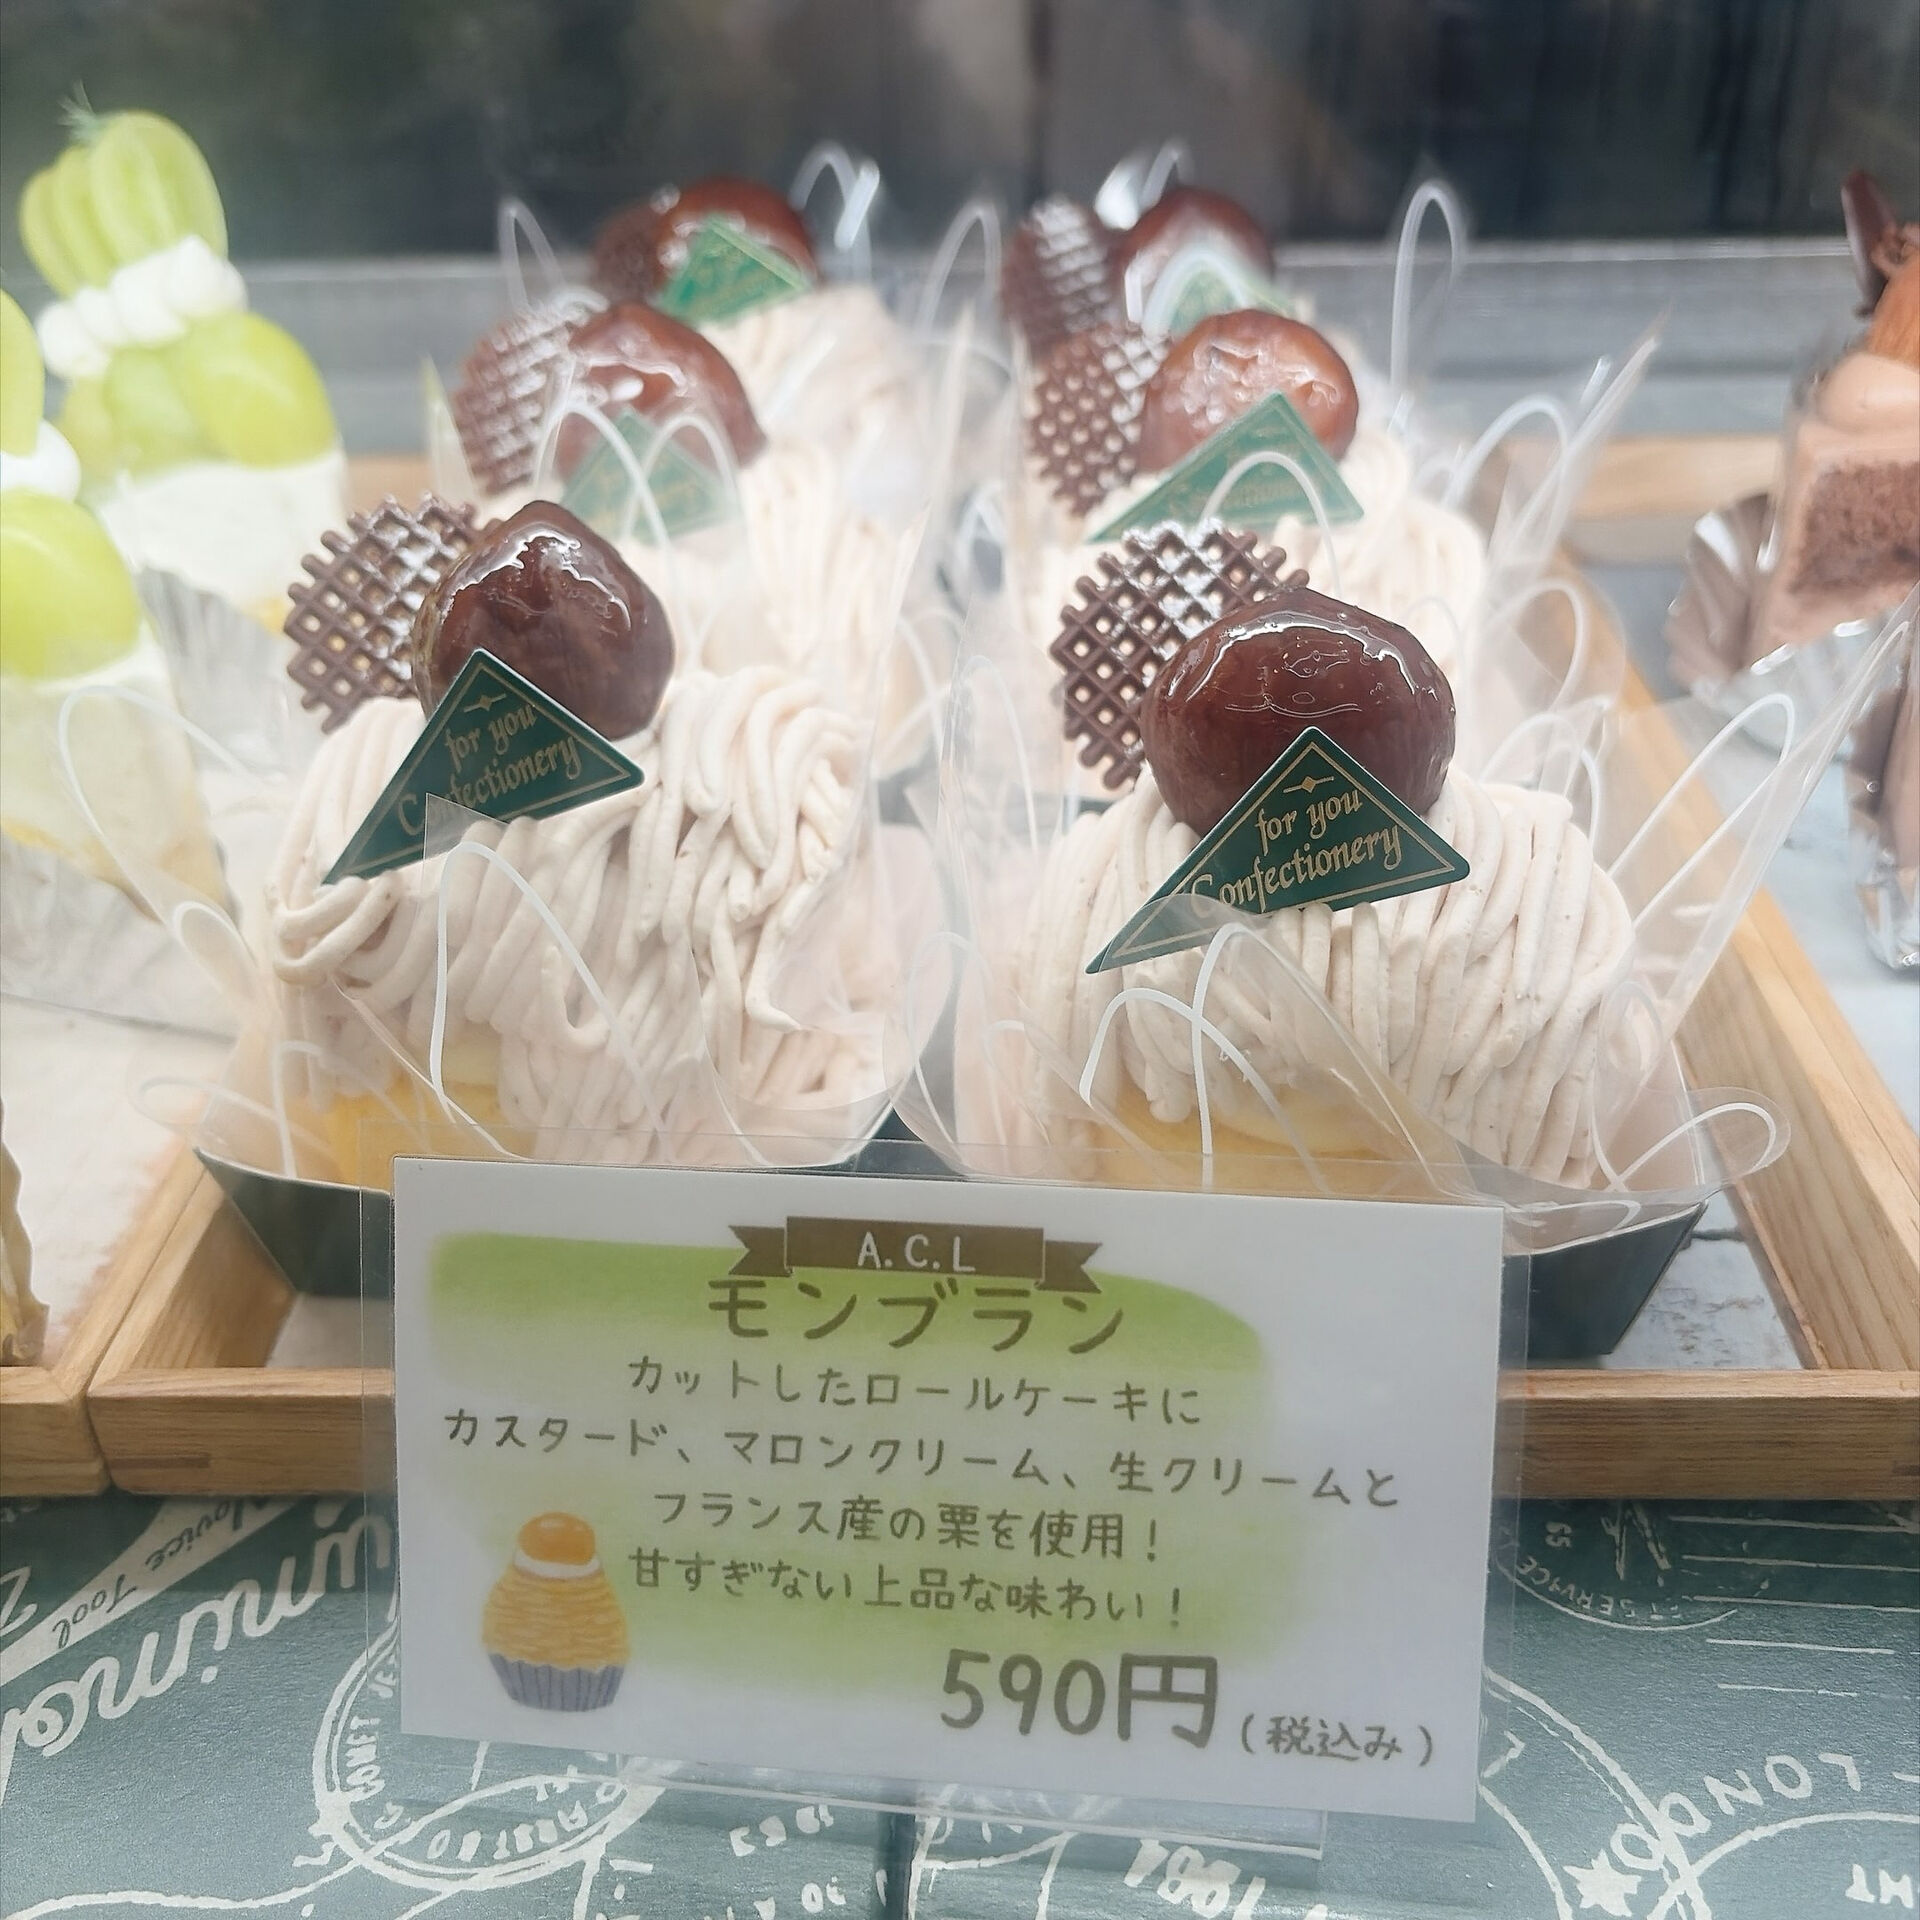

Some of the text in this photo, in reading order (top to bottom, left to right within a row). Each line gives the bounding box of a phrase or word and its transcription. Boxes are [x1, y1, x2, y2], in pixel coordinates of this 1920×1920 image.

[444, 703, 540, 774] for you
[398, 735, 583, 836] Cfectionery
[1254, 788, 1363, 857] for you
[1190, 823, 1403, 918] Confectionery
[856, 1231, 977, 1274] A.C.L
[707, 1276, 1124, 1355] モンブラン
[628, 1355, 1201, 1425] カットしたロールケーキに
[654, 1493, 1158, 1563] フランス産の栗を使用！
[627, 1546, 1182, 1628] 甘すぎない上品な味わい！
[940, 1647, 1219, 1750] 590円
